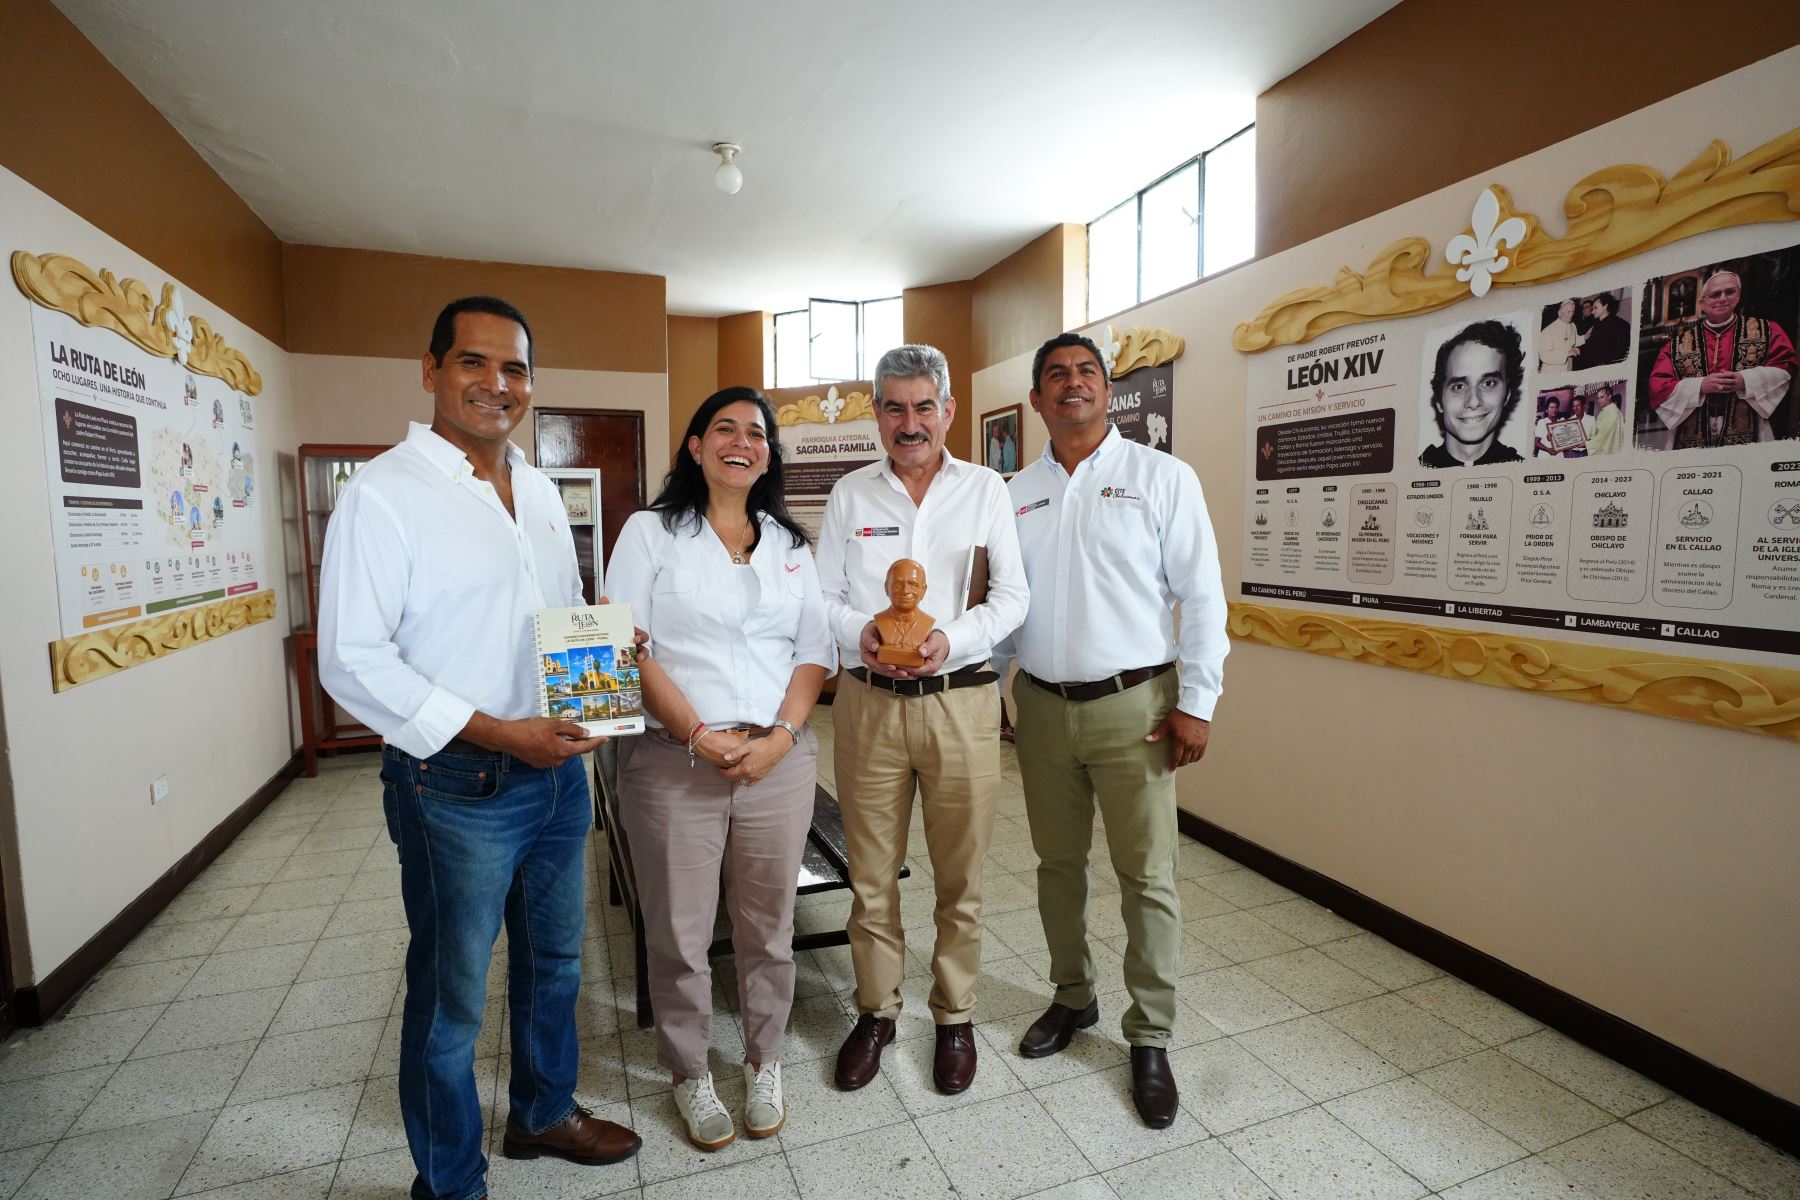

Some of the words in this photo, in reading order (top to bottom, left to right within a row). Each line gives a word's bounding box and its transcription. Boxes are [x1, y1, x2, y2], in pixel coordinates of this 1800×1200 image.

[1288, 355, 1296, 363] DE
[1297, 350, 1318, 361] PADRE
[1319, 344, 1344, 356] ROBERT
[1347, 337, 1378, 349] PREVOST
[50, 341, 68, 366] LA
[70, 348, 101, 374] RUTA
[104, 361, 117, 382] DE
[120, 368, 146, 390] LEÓN
[1288, 358, 1339, 390] LEÓN
[1343, 349, 1384, 380] XIV
[52, 369, 71, 382] OCHO
[71, 374, 98, 392] LUGARES,
[100, 383, 111, 395] UNA
[112, 387, 135, 401] HISTORIA
[135, 394, 146, 406] QUE
[1268, 411, 1292, 421] CAMINO
[1293, 409, 1302, 417] DE
[1333, 398, 1365, 410] SERVICIO
[1117, 412, 1140, 424] CAMINO
[802, 435, 837, 443] PARROQUIA
[838, 434, 870, 442] CATEDRAL
[796, 446, 837, 455] SAGRADA
[838, 442, 876, 453] FAMILIA
[1702, 471, 1722, 479] 2021
[1682, 488, 1713, 496] CALLAO
[1752, 545, 1765, 553] DE
[1758, 554, 1800, 562] UNIVERS
[1664, 561, 1690, 569] Mientras
[1698, 562, 1720, 570] obispo
[1706, 579, 1715, 587] de
[1751, 583, 1772, 591] Roma
[1362, 596, 1379, 604] PIURA
[1763, 593, 1798, 601] Cardenal.
[1468, 606, 1503, 616] LIBERTAD
[571, 613, 594, 623] RUTA
[1580, 617, 1641, 631] LAMBAYEQUE
[1677, 627, 1720, 639] CALLAO
